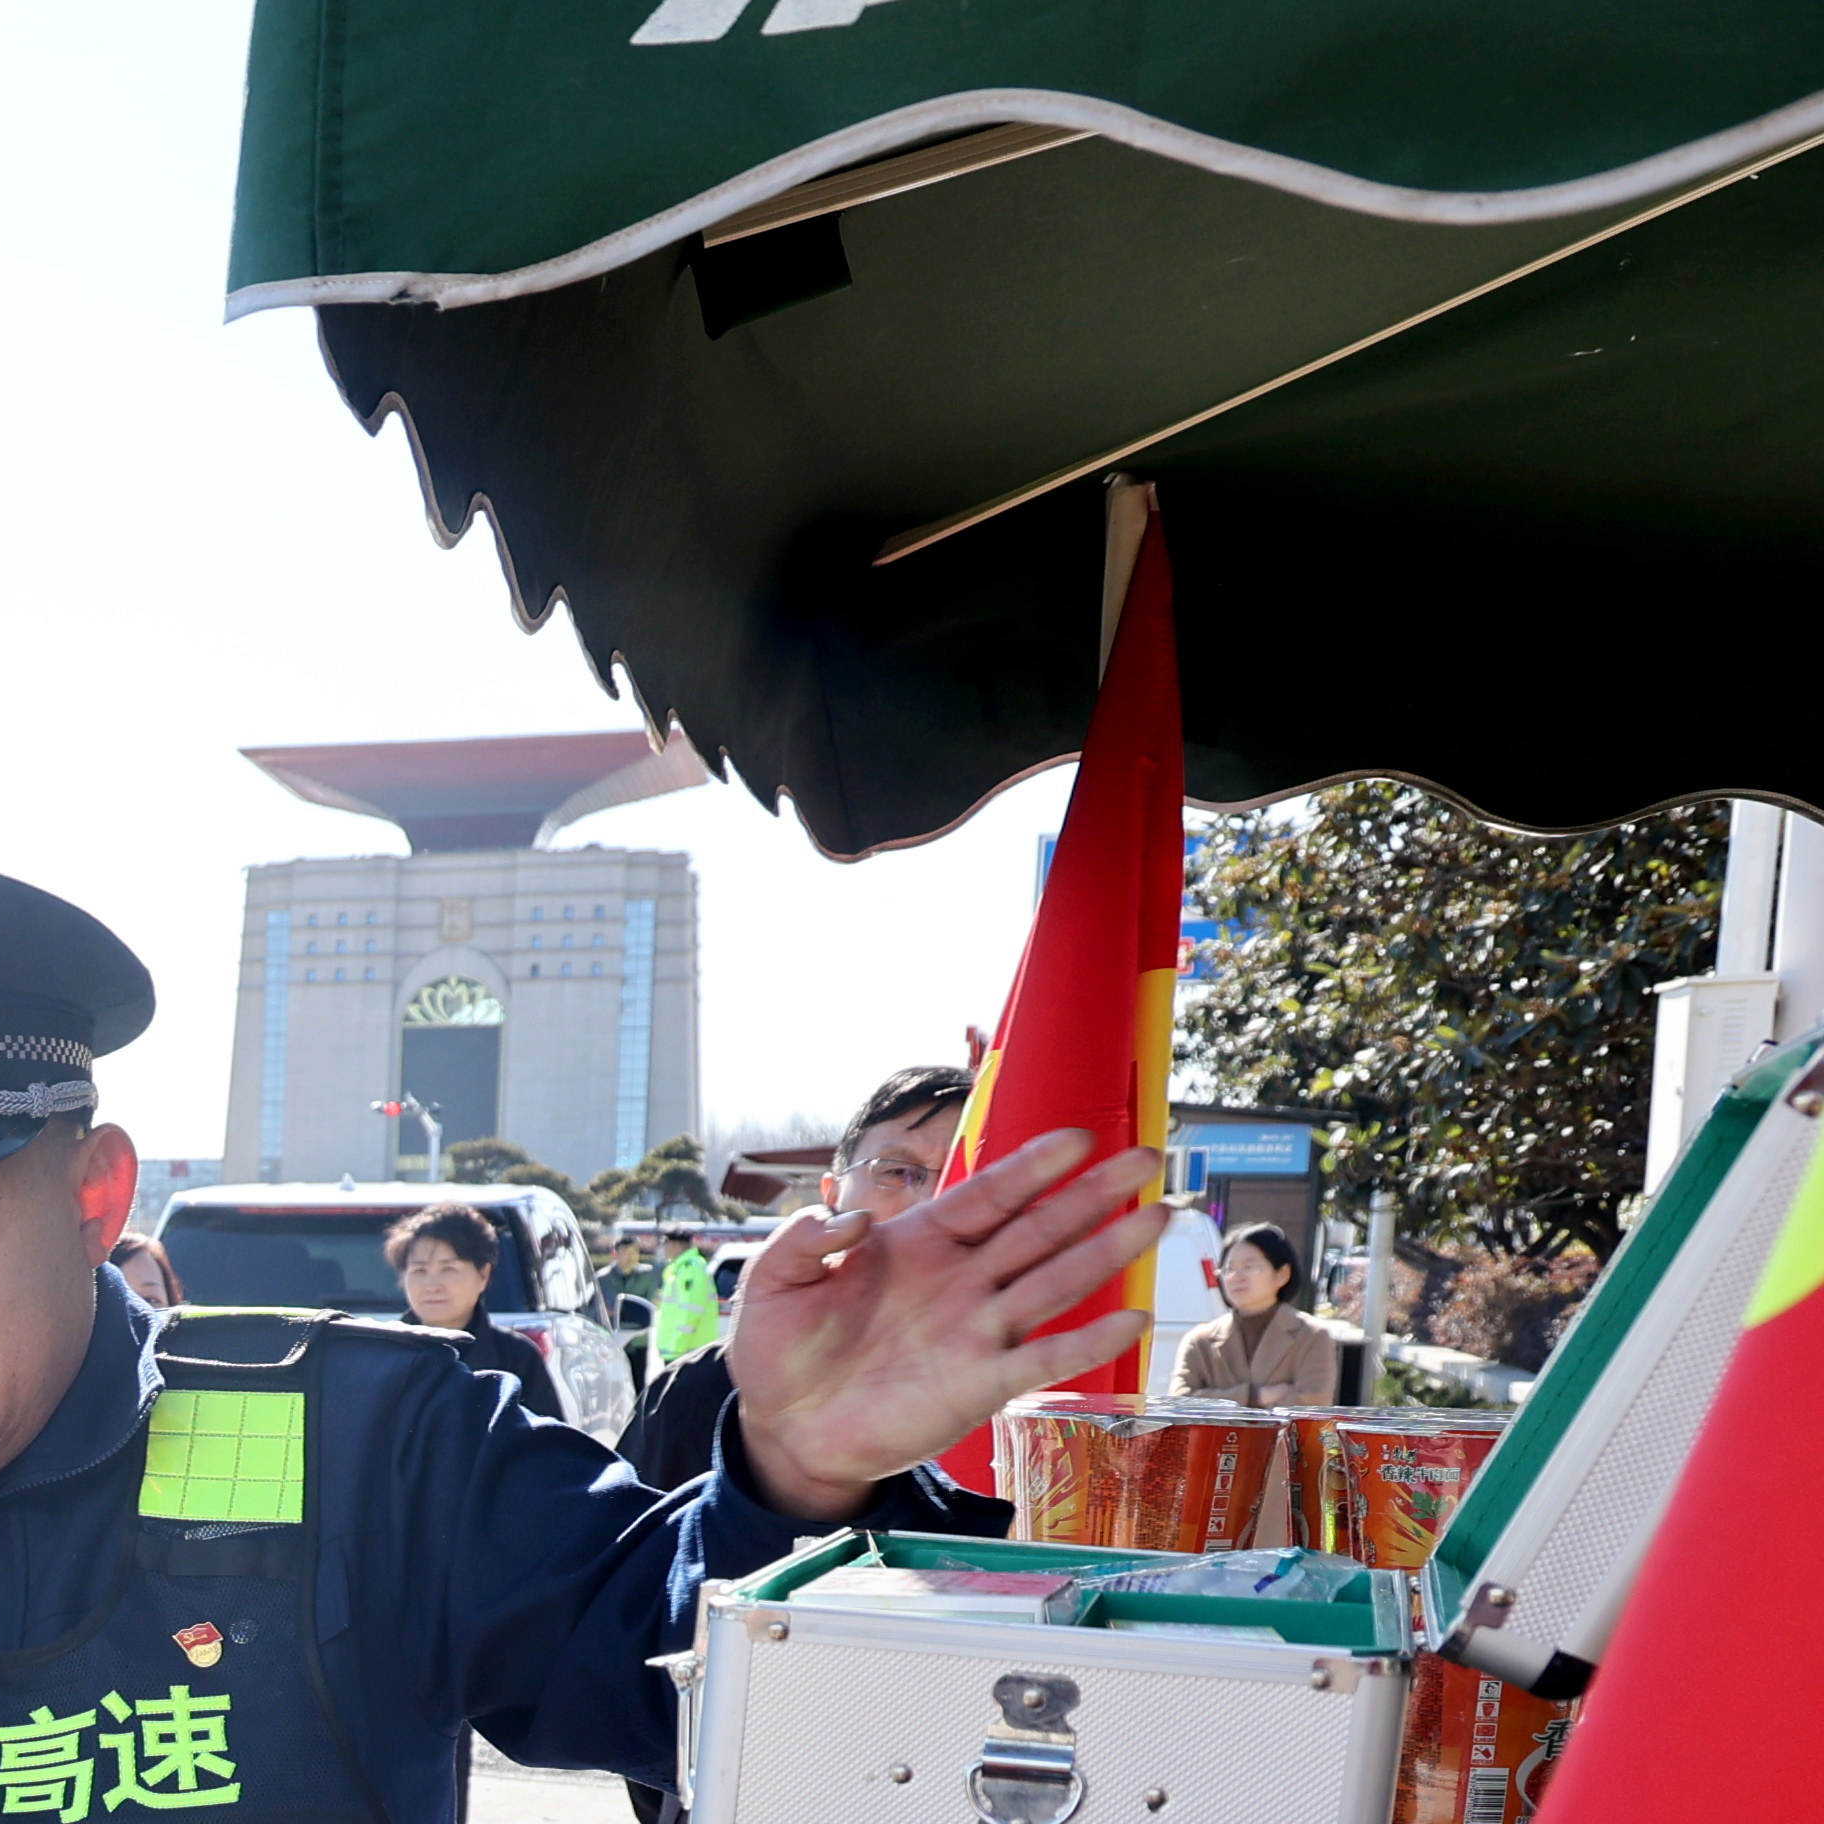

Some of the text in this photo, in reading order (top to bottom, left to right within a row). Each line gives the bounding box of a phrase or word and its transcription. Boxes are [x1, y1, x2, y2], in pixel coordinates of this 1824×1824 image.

[1380, 1464, 1461, 1483] 香辣牛肉面
